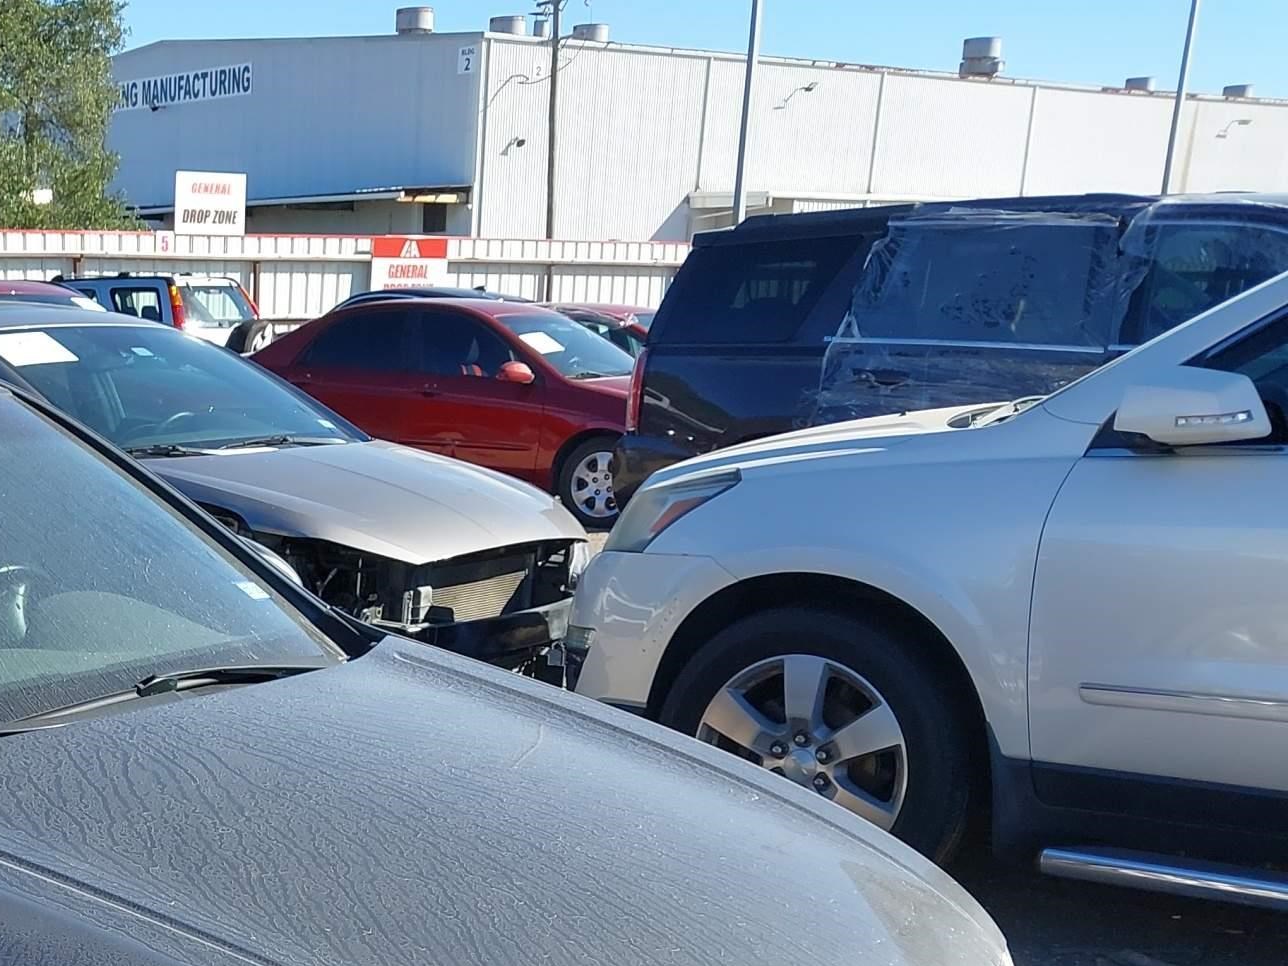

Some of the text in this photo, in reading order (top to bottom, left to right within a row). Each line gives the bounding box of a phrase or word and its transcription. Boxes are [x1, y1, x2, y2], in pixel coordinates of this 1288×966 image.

[464, 57, 471, 72] 2
[142, 65, 251, 107] MANUFACTURING
[191, 182, 231, 195] GENERAL
[182, 209, 238, 225] DROP ZONE
[161, 236, 169, 252] 5
[388, 264, 428, 279] GENERAL
